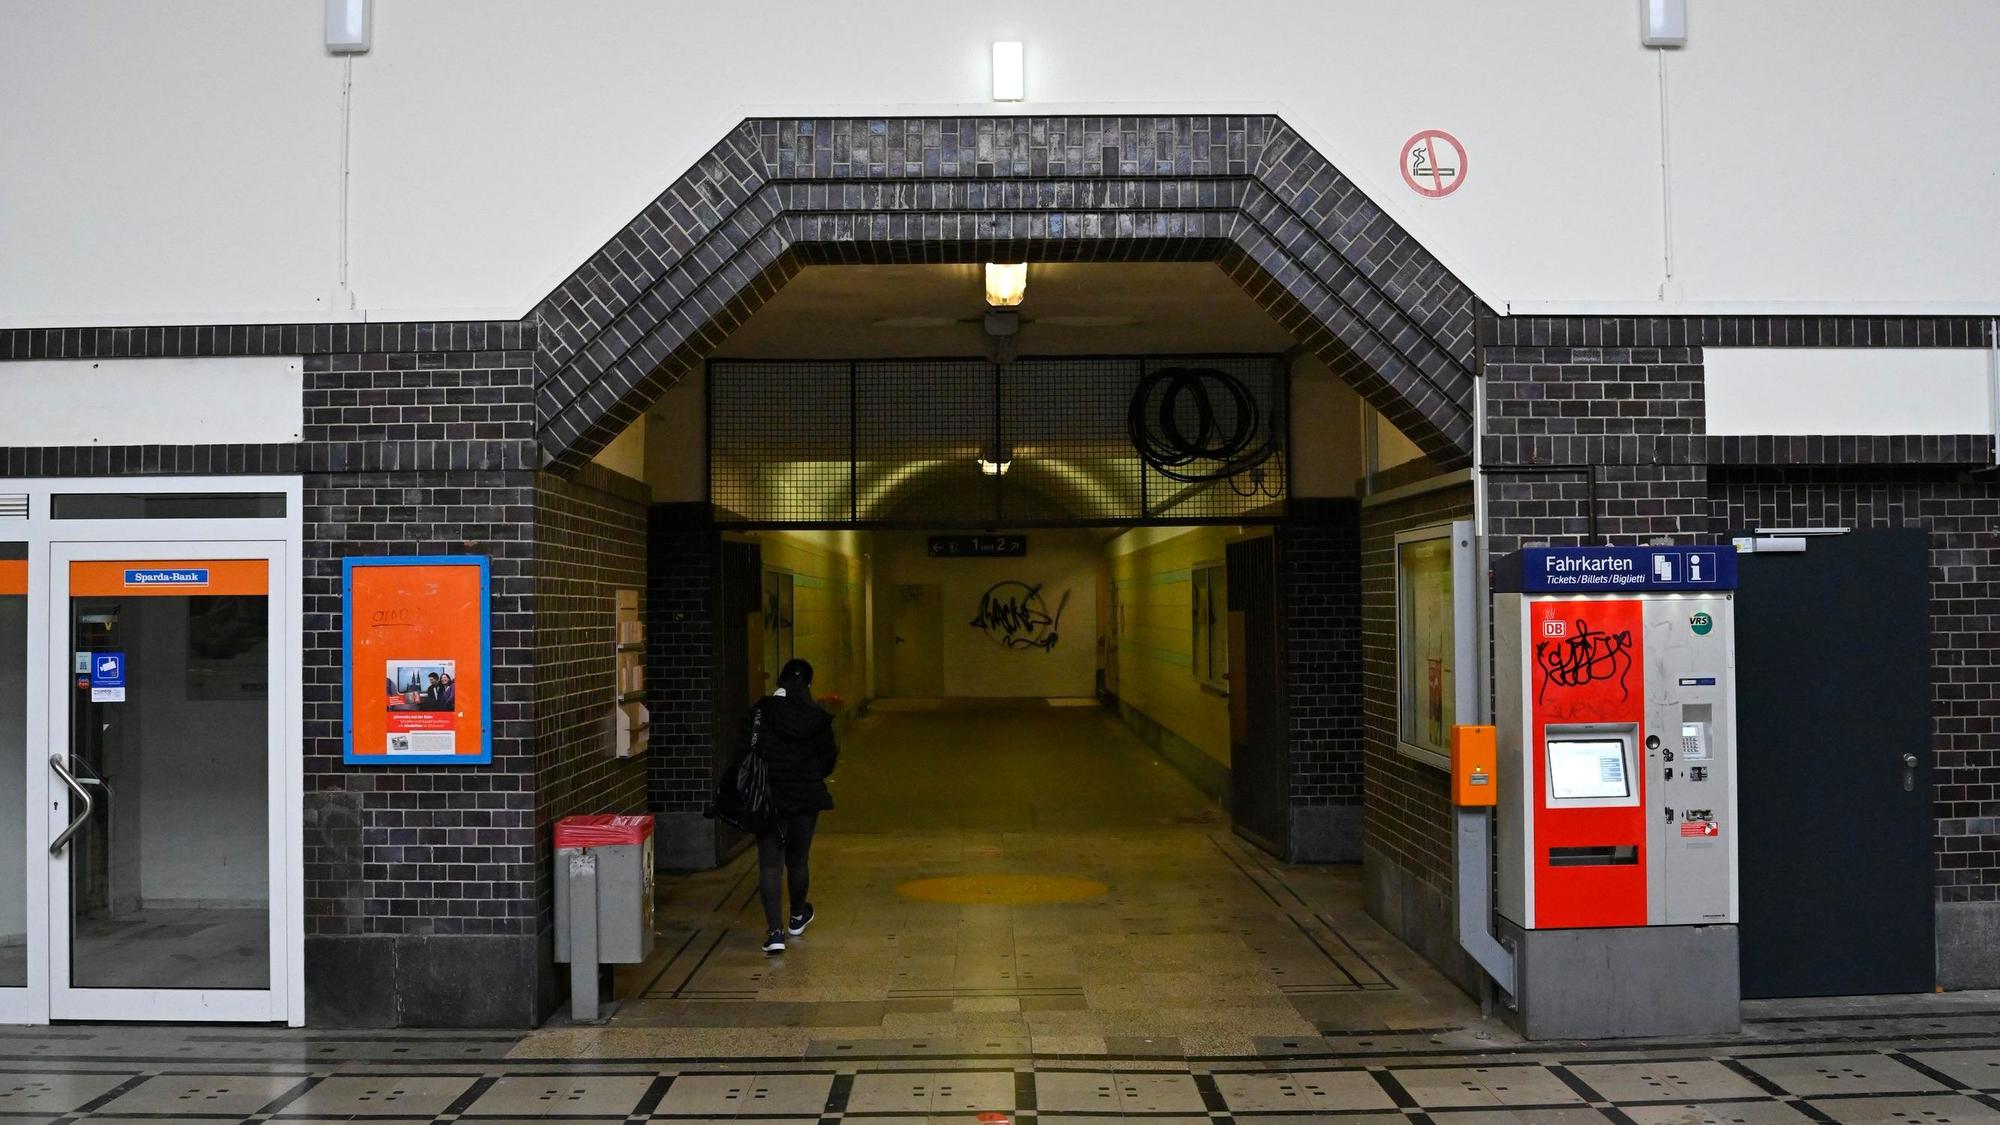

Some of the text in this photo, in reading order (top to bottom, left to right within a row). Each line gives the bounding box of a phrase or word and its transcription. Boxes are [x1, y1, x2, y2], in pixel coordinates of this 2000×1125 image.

[972, 537, 979, 551] 1
[996, 537, 1006, 551] 2
[1545, 556, 1633, 572] Fahrkarten
[135, 572, 199, 583] Sparda-Bank
[1690, 617, 1707, 625] VRS
[1546, 623, 1563, 635] DB
